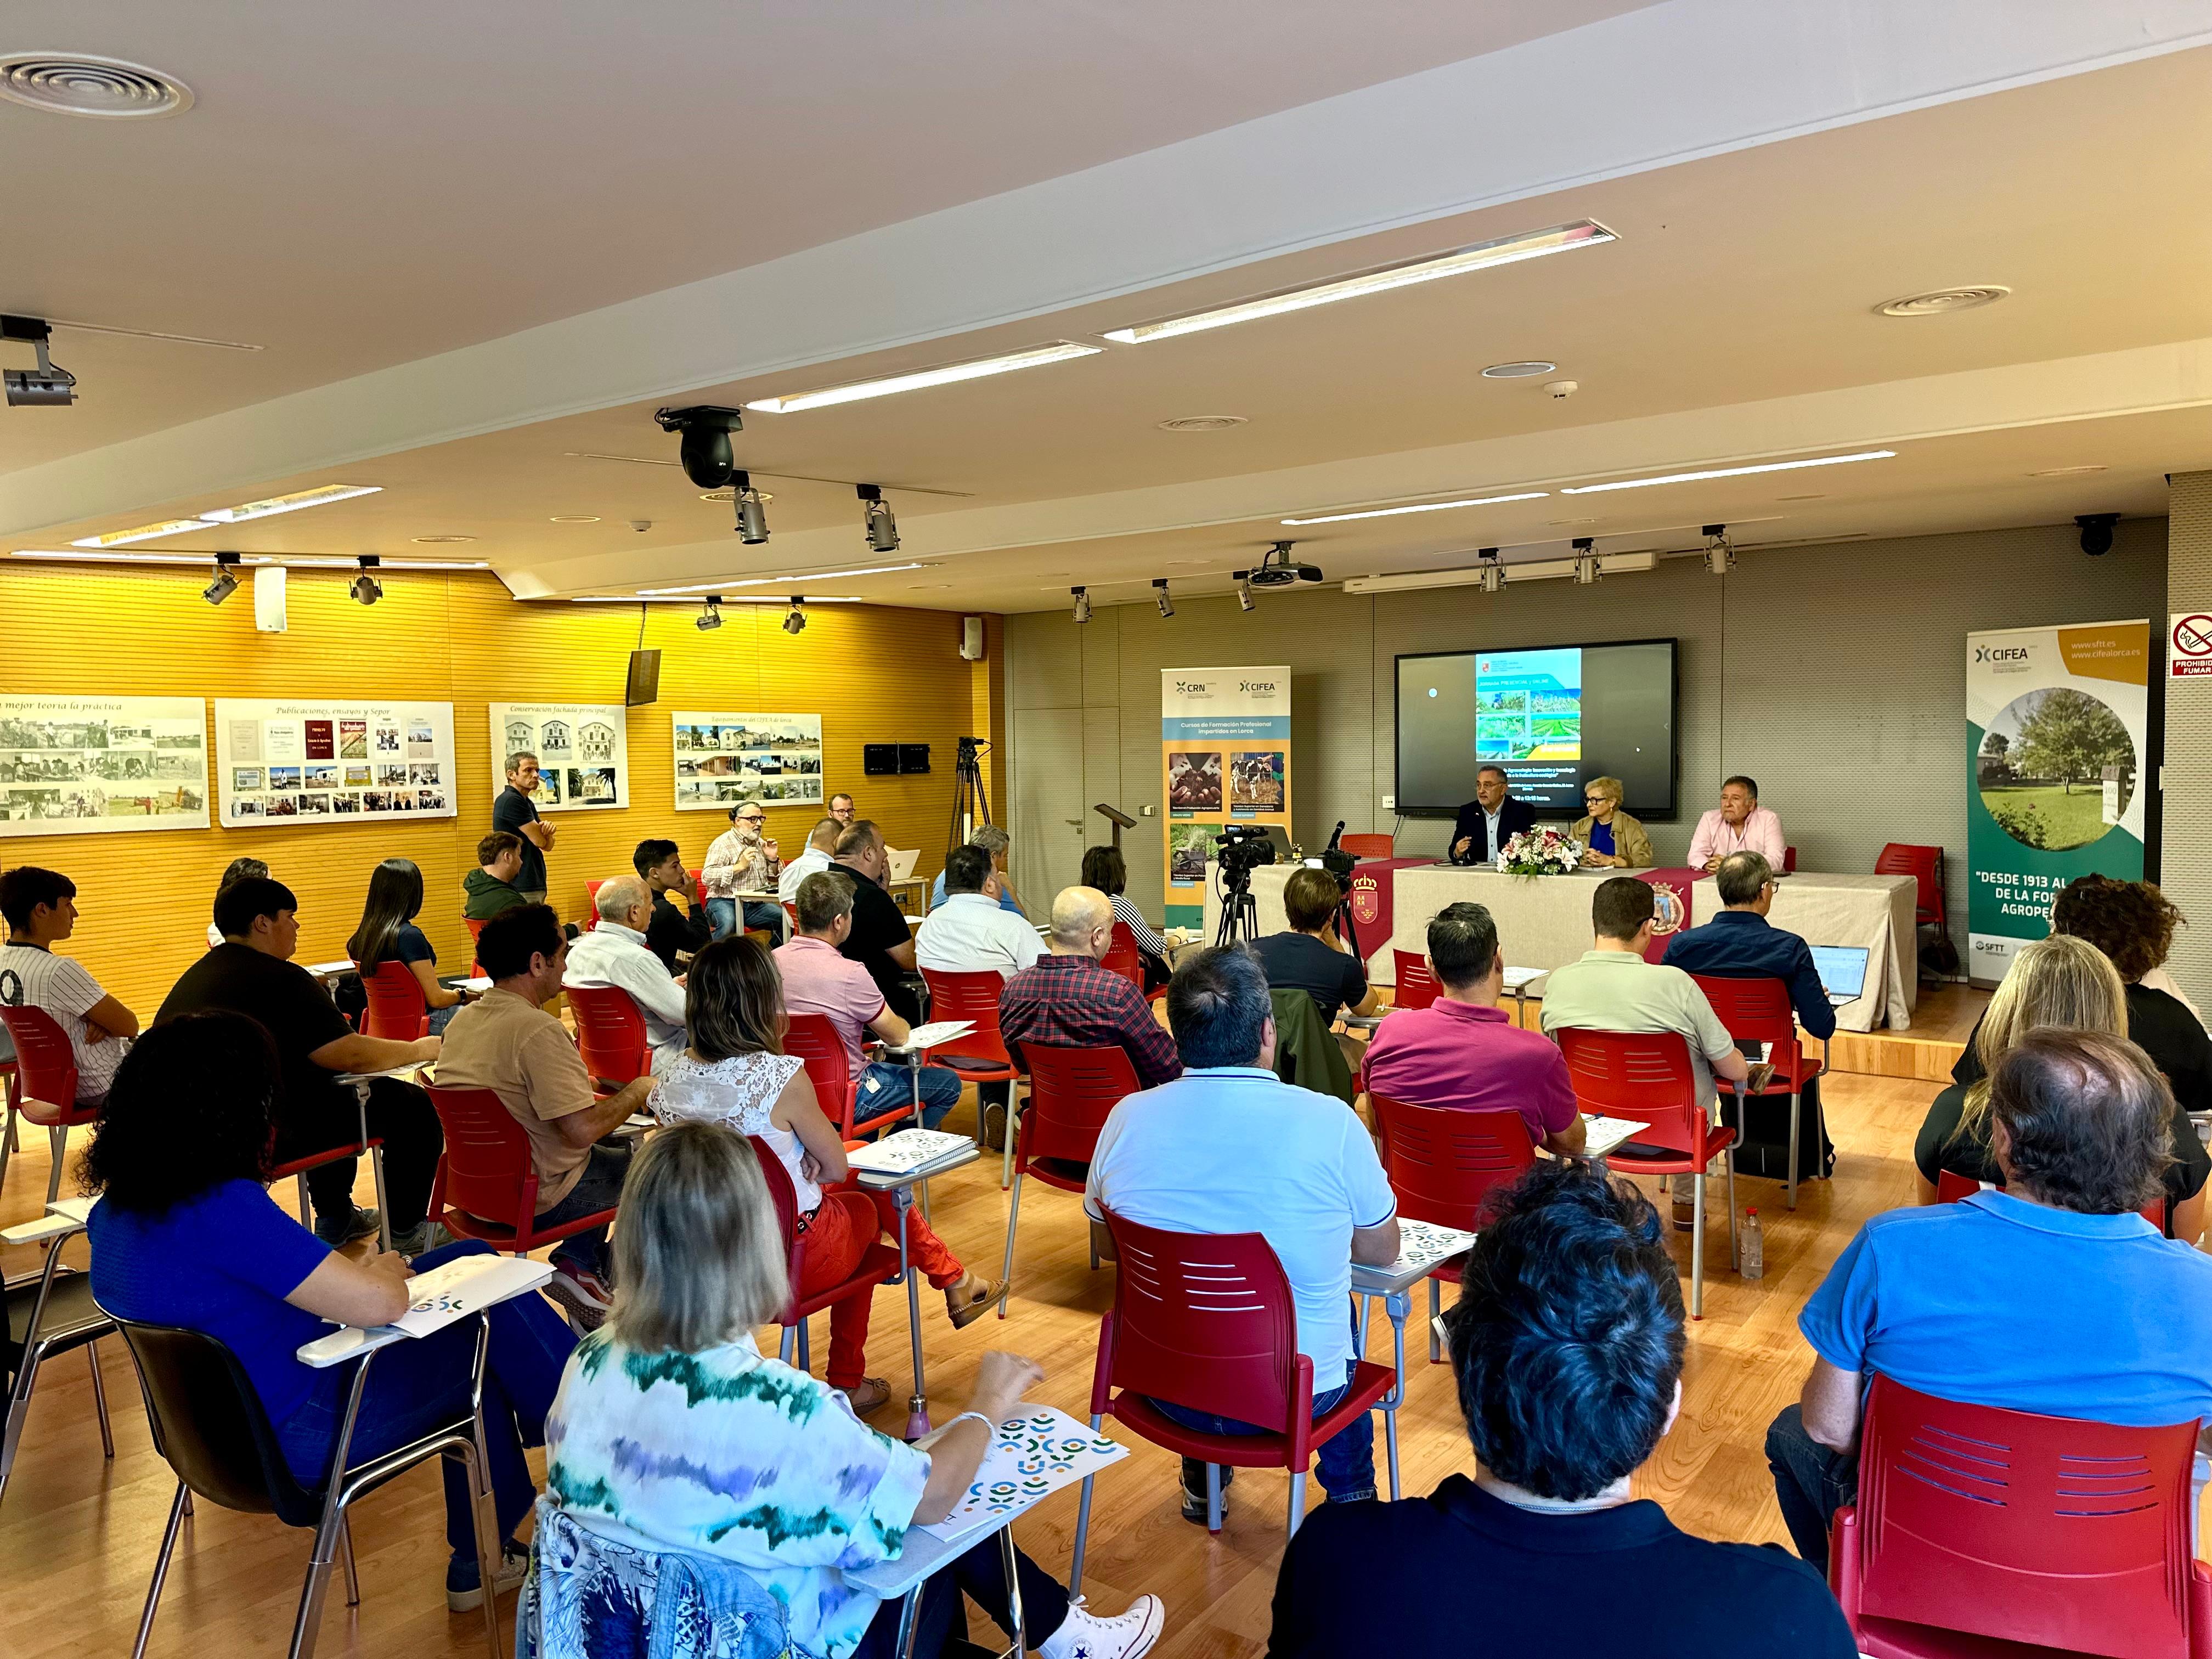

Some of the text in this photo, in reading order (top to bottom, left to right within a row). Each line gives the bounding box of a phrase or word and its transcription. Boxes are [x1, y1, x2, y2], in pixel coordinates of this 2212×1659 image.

[2071, 640, 2116, 649] www.sftt.es
[1993, 648, 2028, 661] CIFEA
[2071, 649, 2141, 659] www.cifealorca.es
[5, 702, 34, 712] mejor
[70, 701, 78, 710] la
[553, 706, 578, 714] fachada
[579, 707, 607, 715] principal
[370, 708, 391, 716] Sepor
[1976, 871, 2067, 889] "DESDE 1913 AL
[1995, 888, 2011, 900] DE
[2014, 889, 2029, 901] LA
[1985, 943, 2004, 952] SFTT
